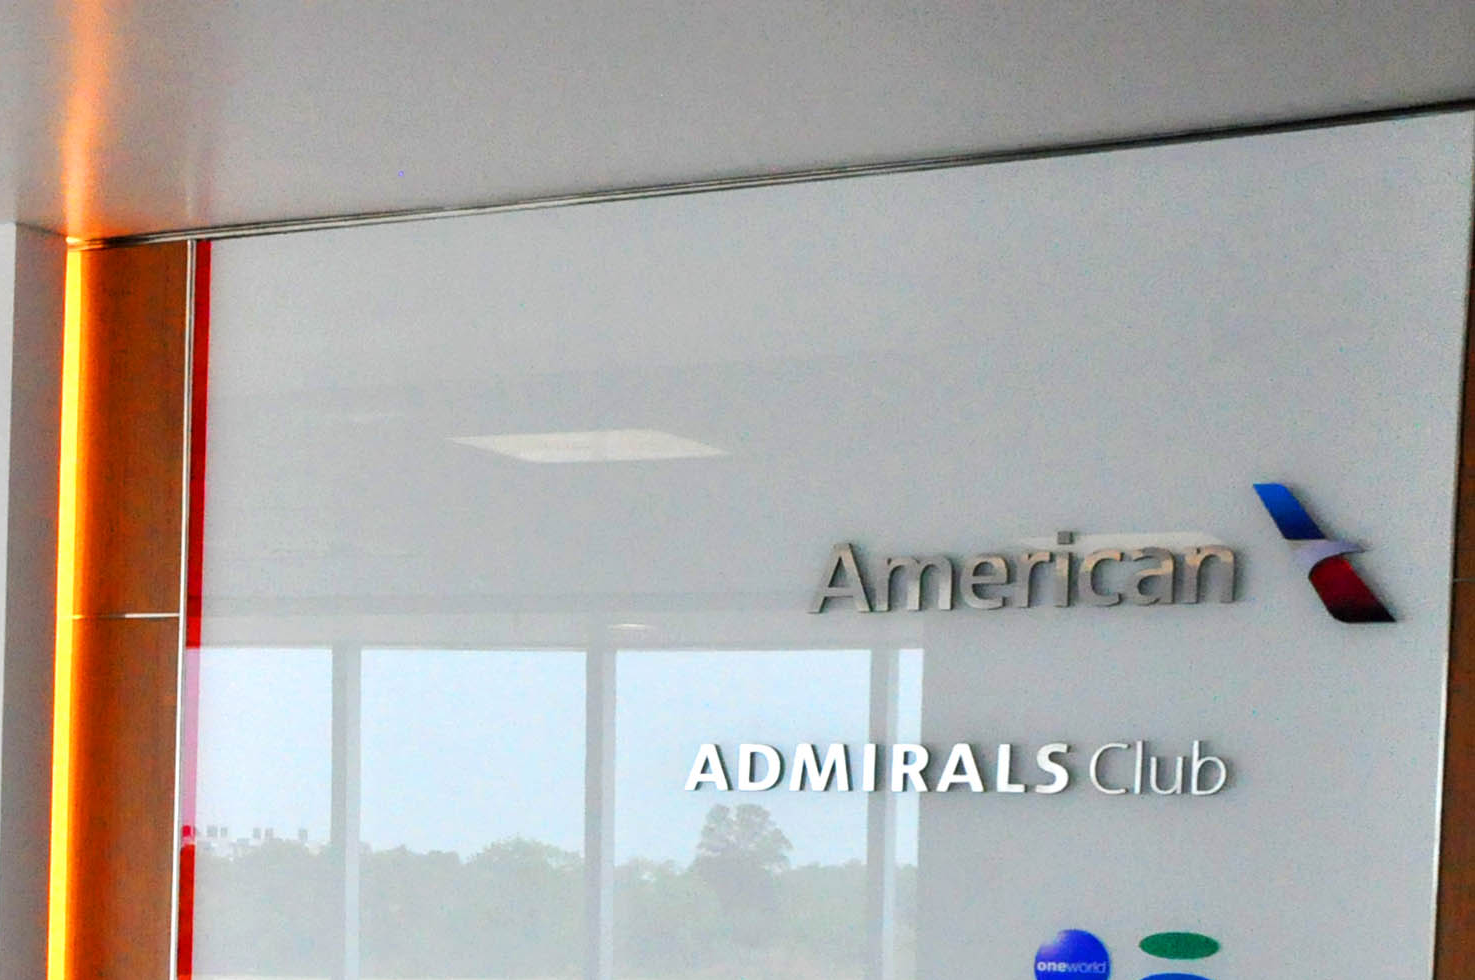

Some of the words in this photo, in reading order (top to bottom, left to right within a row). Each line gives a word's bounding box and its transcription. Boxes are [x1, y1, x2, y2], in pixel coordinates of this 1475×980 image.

[809, 531, 1238, 614] American
[685, 742, 1072, 794] ADMIRALS
[1089, 740, 1228, 796] Club
[1036, 960, 1107, 974] oneworld
